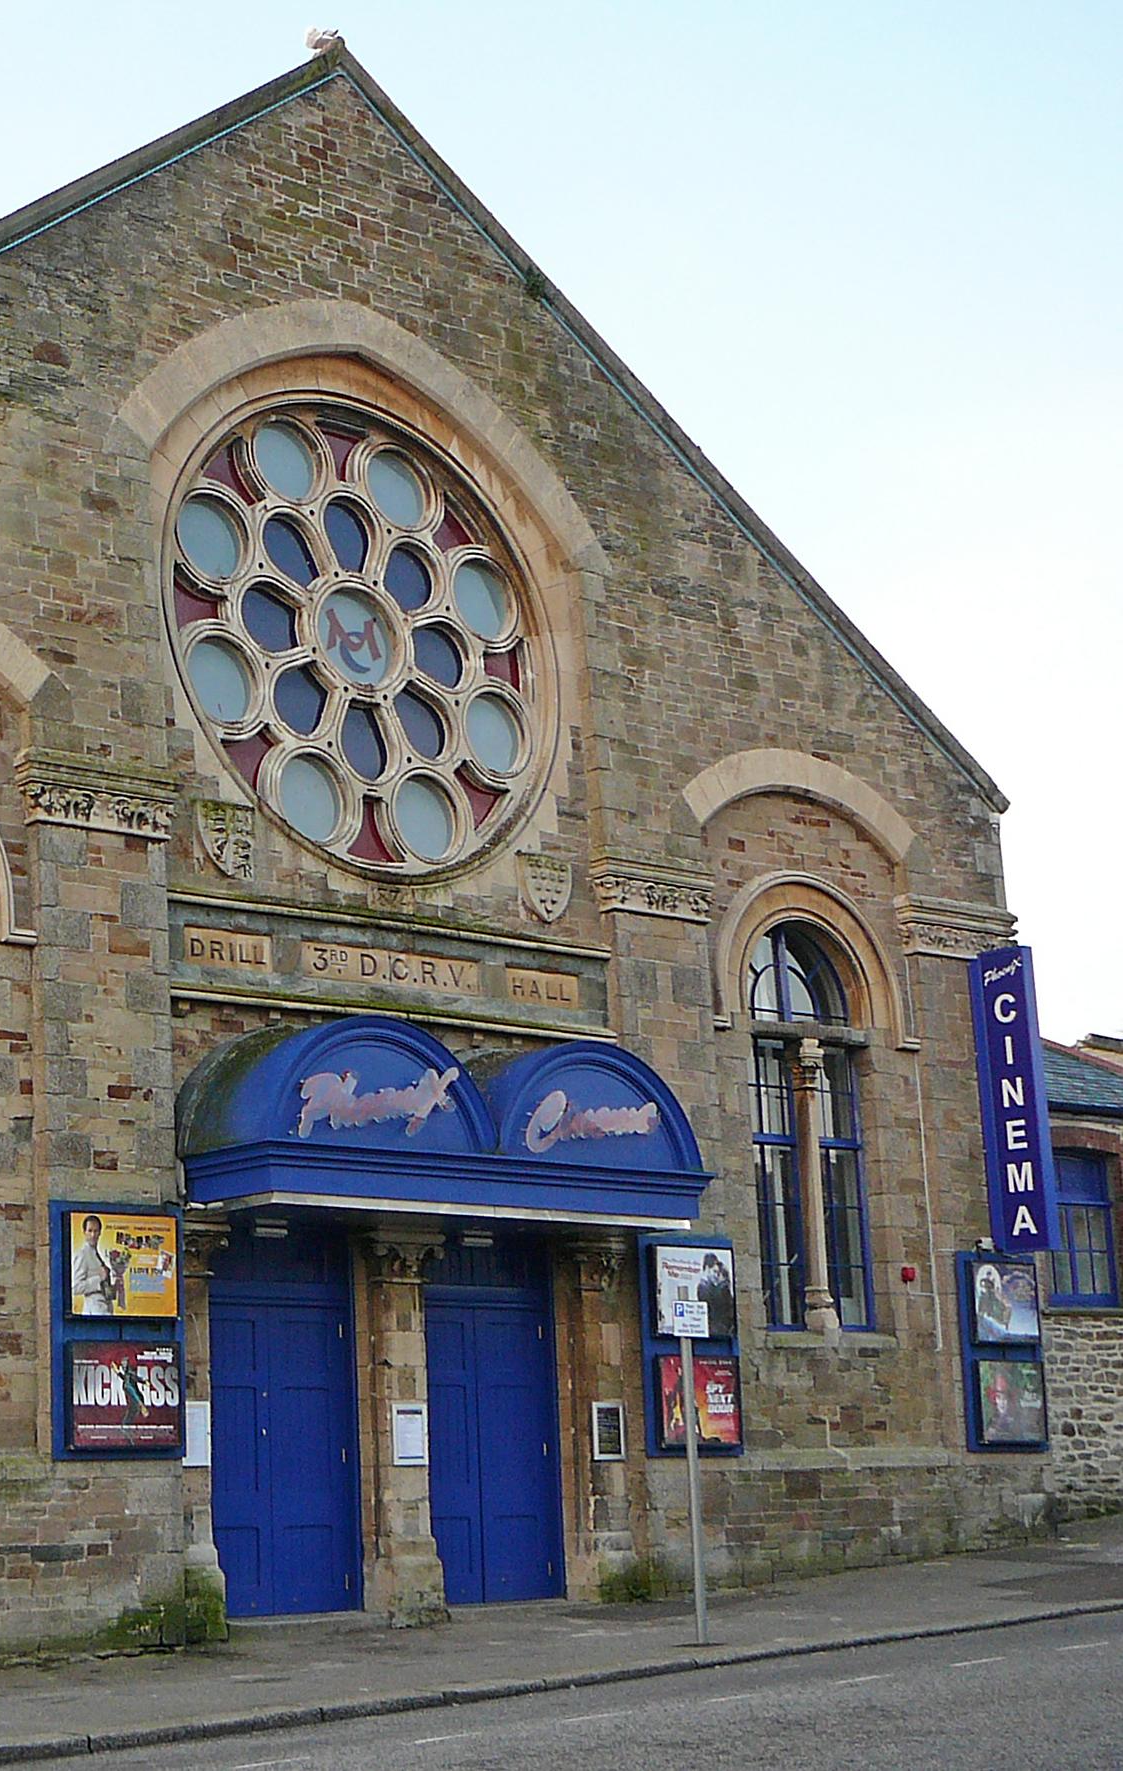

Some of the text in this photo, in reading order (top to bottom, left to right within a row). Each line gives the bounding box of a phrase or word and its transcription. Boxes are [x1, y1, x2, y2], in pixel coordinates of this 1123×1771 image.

[189, 937, 267, 966] DRILL
[512, 976, 572, 1001] HALL
[993, 993, 1039, 1236] CINEMA
[706, 1383, 725, 1394] SPY
[707, 1393, 734, 1404] NEXT
[708, 1403, 734, 1414] DOOR
